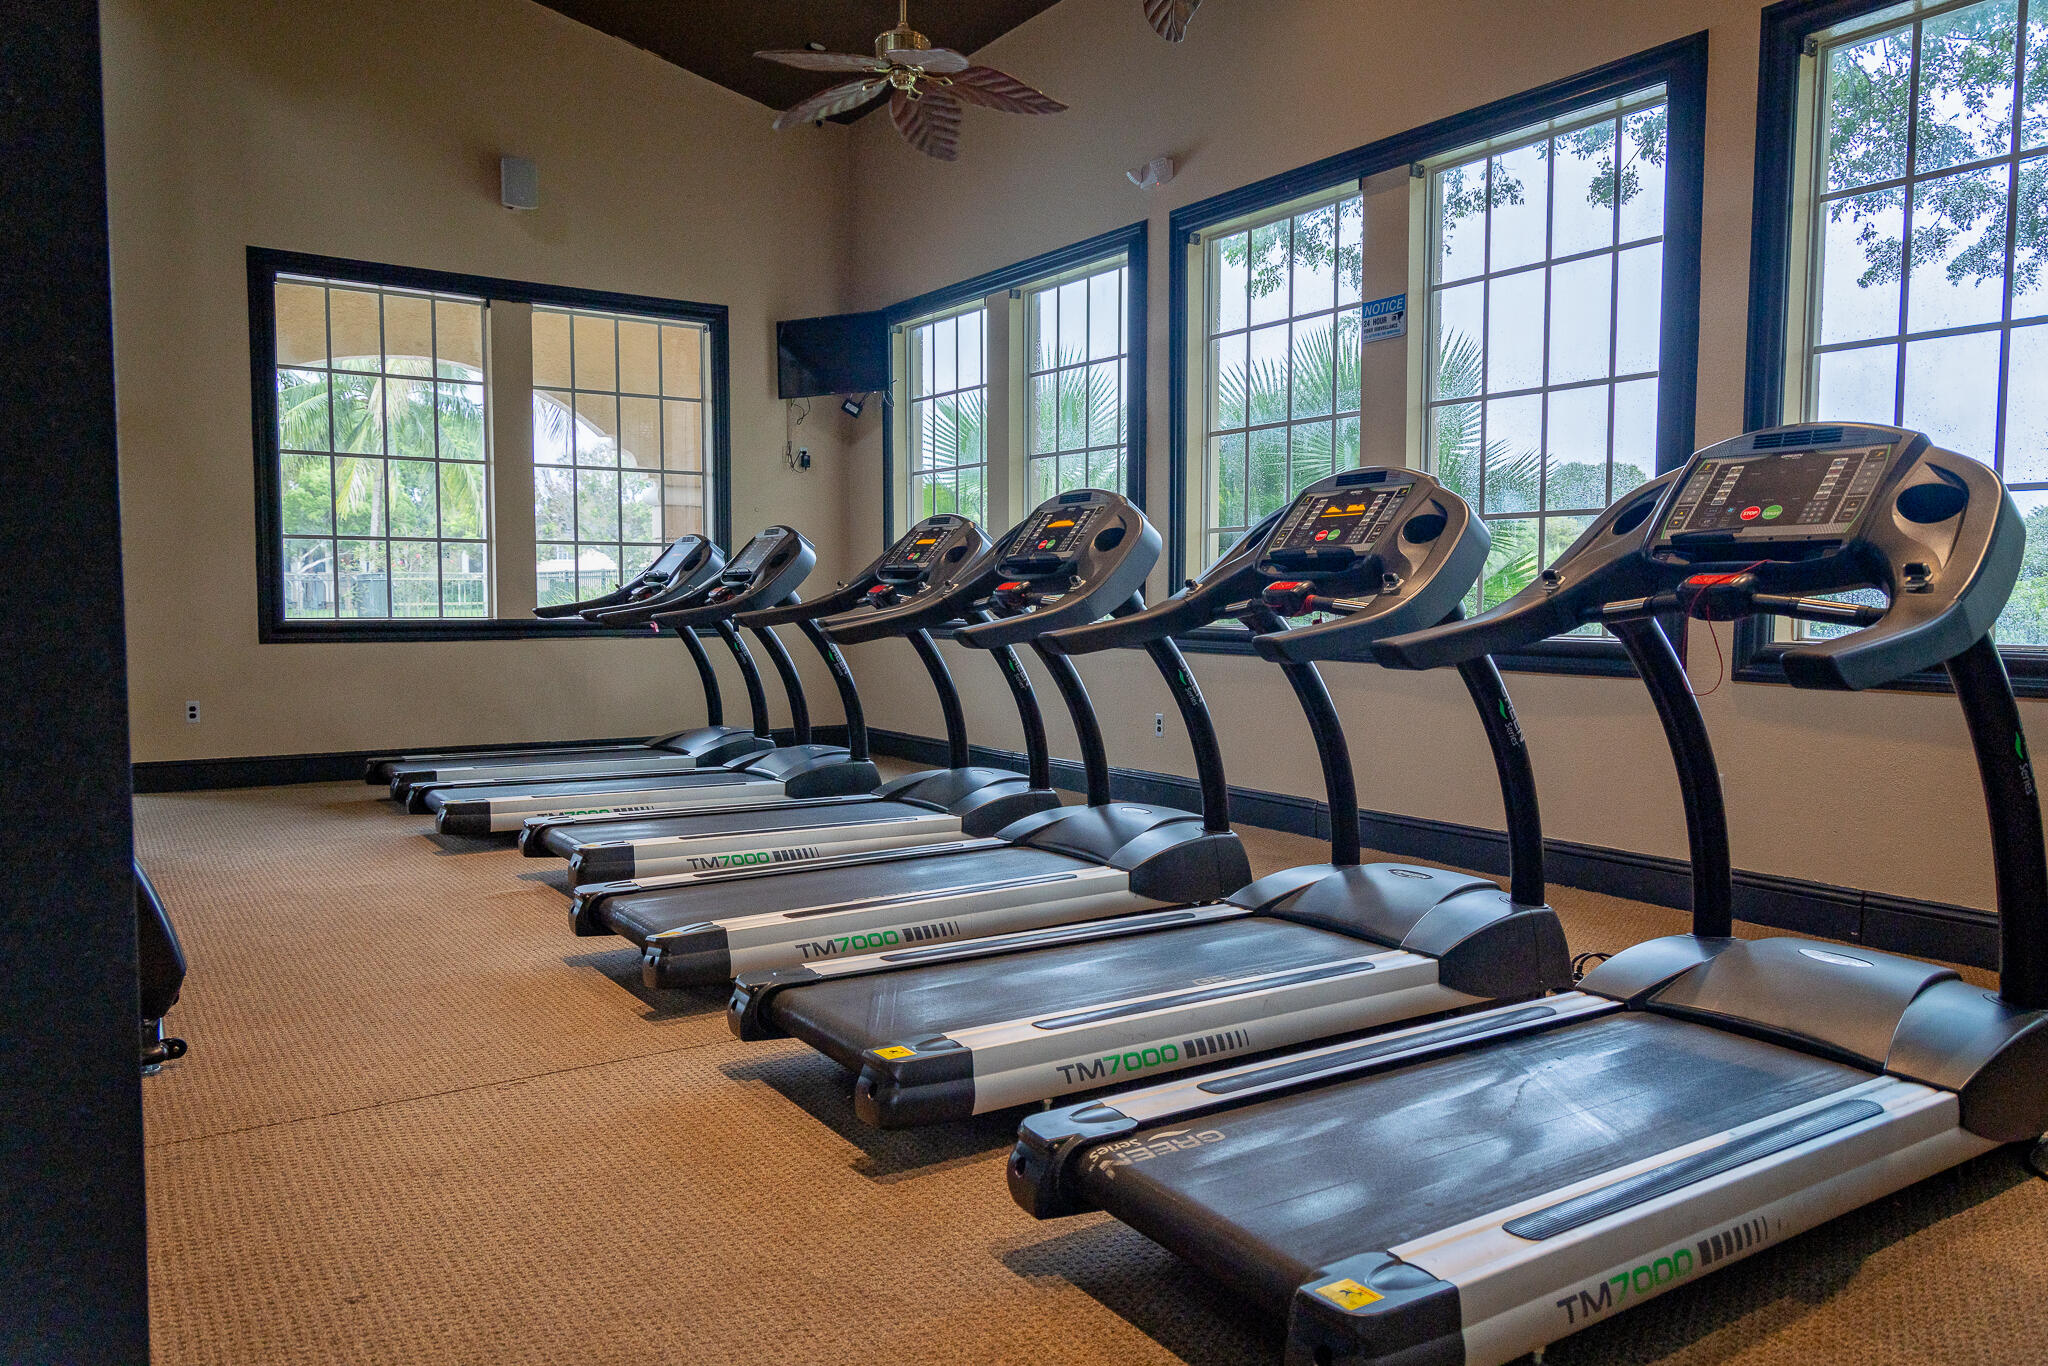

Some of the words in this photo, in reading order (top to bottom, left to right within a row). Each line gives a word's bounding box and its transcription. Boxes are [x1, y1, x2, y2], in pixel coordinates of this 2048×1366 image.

[1364, 297, 1404, 316] NOTICE
[1363, 320, 1370, 328] 24
[1373, 316, 1387, 325] HOUR
[1504, 721, 1518, 746] Series
[2019, 762, 2034, 796] Series
[687, 851, 770, 870] TM7000
[795, 929, 899, 958] TM7000
[1056, 1043, 1179, 1084] TM7000
[1089, 1138, 1138, 1163] Series
[1098, 1129, 1226, 1180] GREEN
[1557, 1248, 1694, 1324] TM7000
